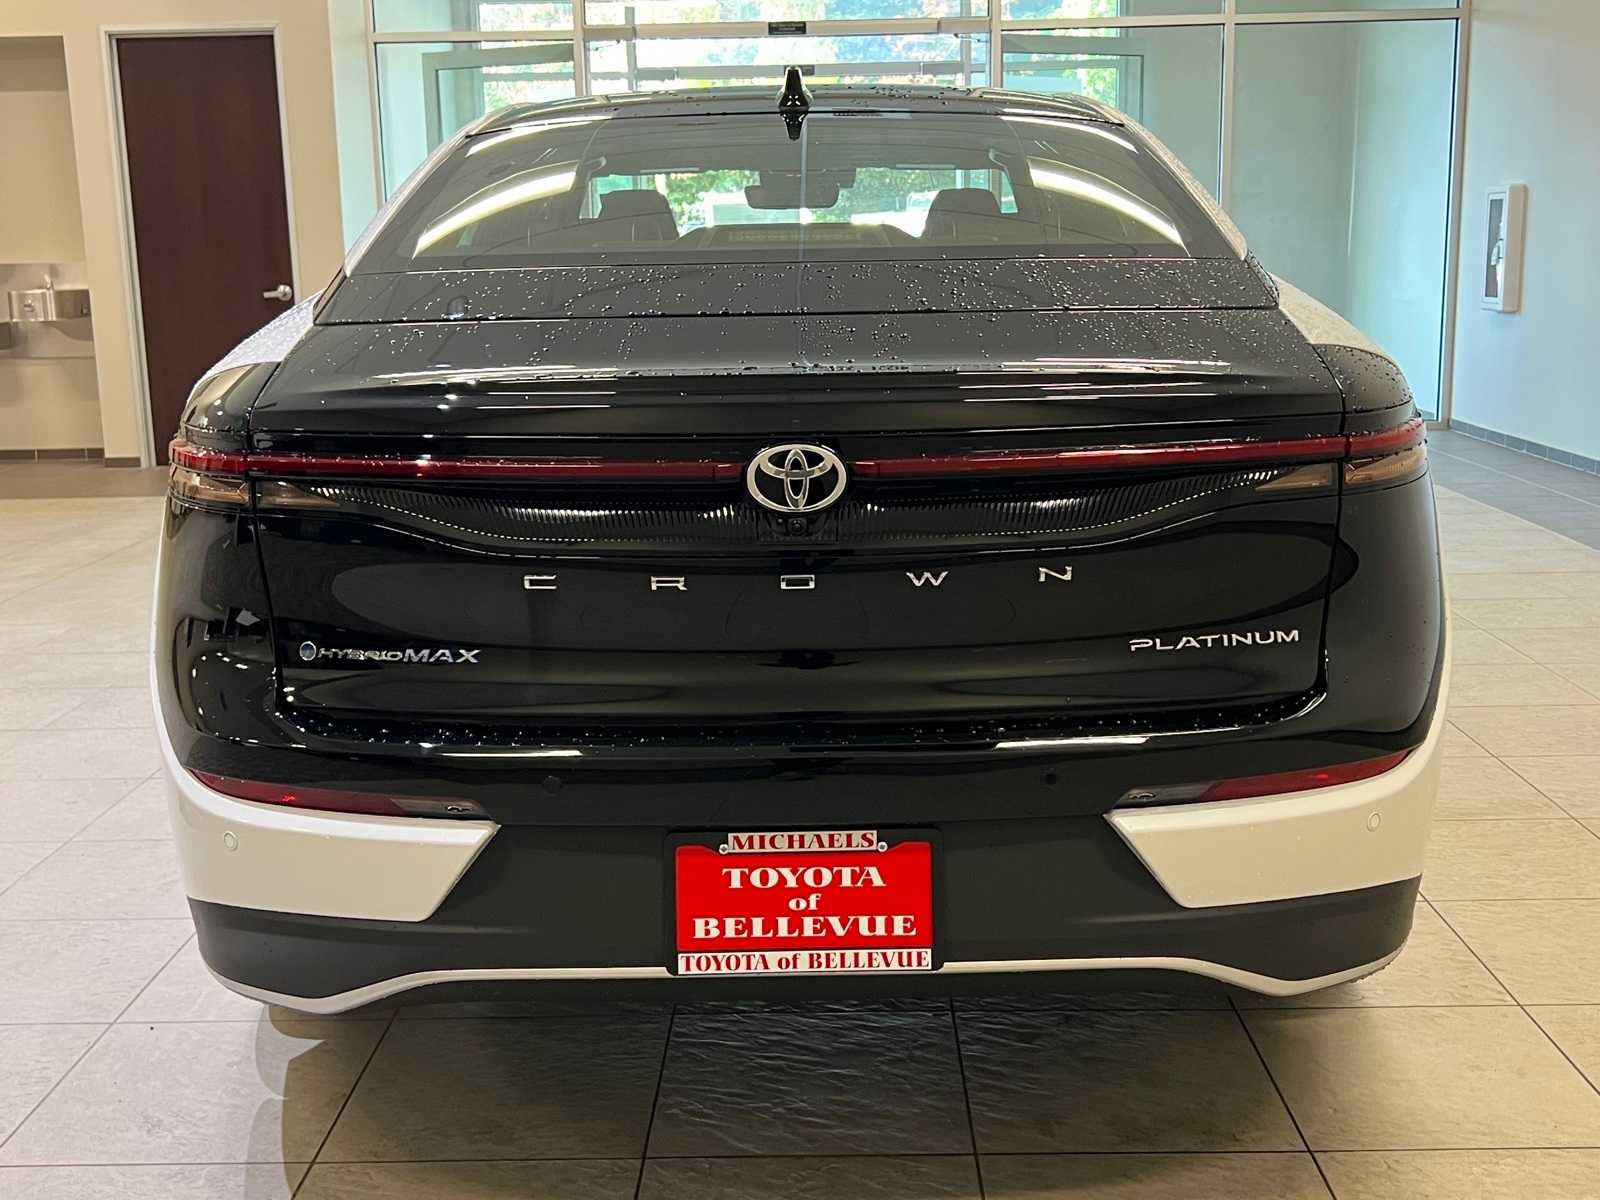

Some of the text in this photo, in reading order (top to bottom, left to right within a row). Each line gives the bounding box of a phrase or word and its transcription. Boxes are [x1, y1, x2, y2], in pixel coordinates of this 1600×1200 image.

[523, 564, 1073, 592] CROWN
[1129, 630, 1299, 652] PLATINUM
[731, 832, 874, 850] MICHAELS
[722, 866, 887, 889] TOYOTA
[788, 893, 822, 911] of
[692, 915, 917, 939] BELLEVUE
[680, 950, 930, 973] TOYOTA of BELLEVUE
